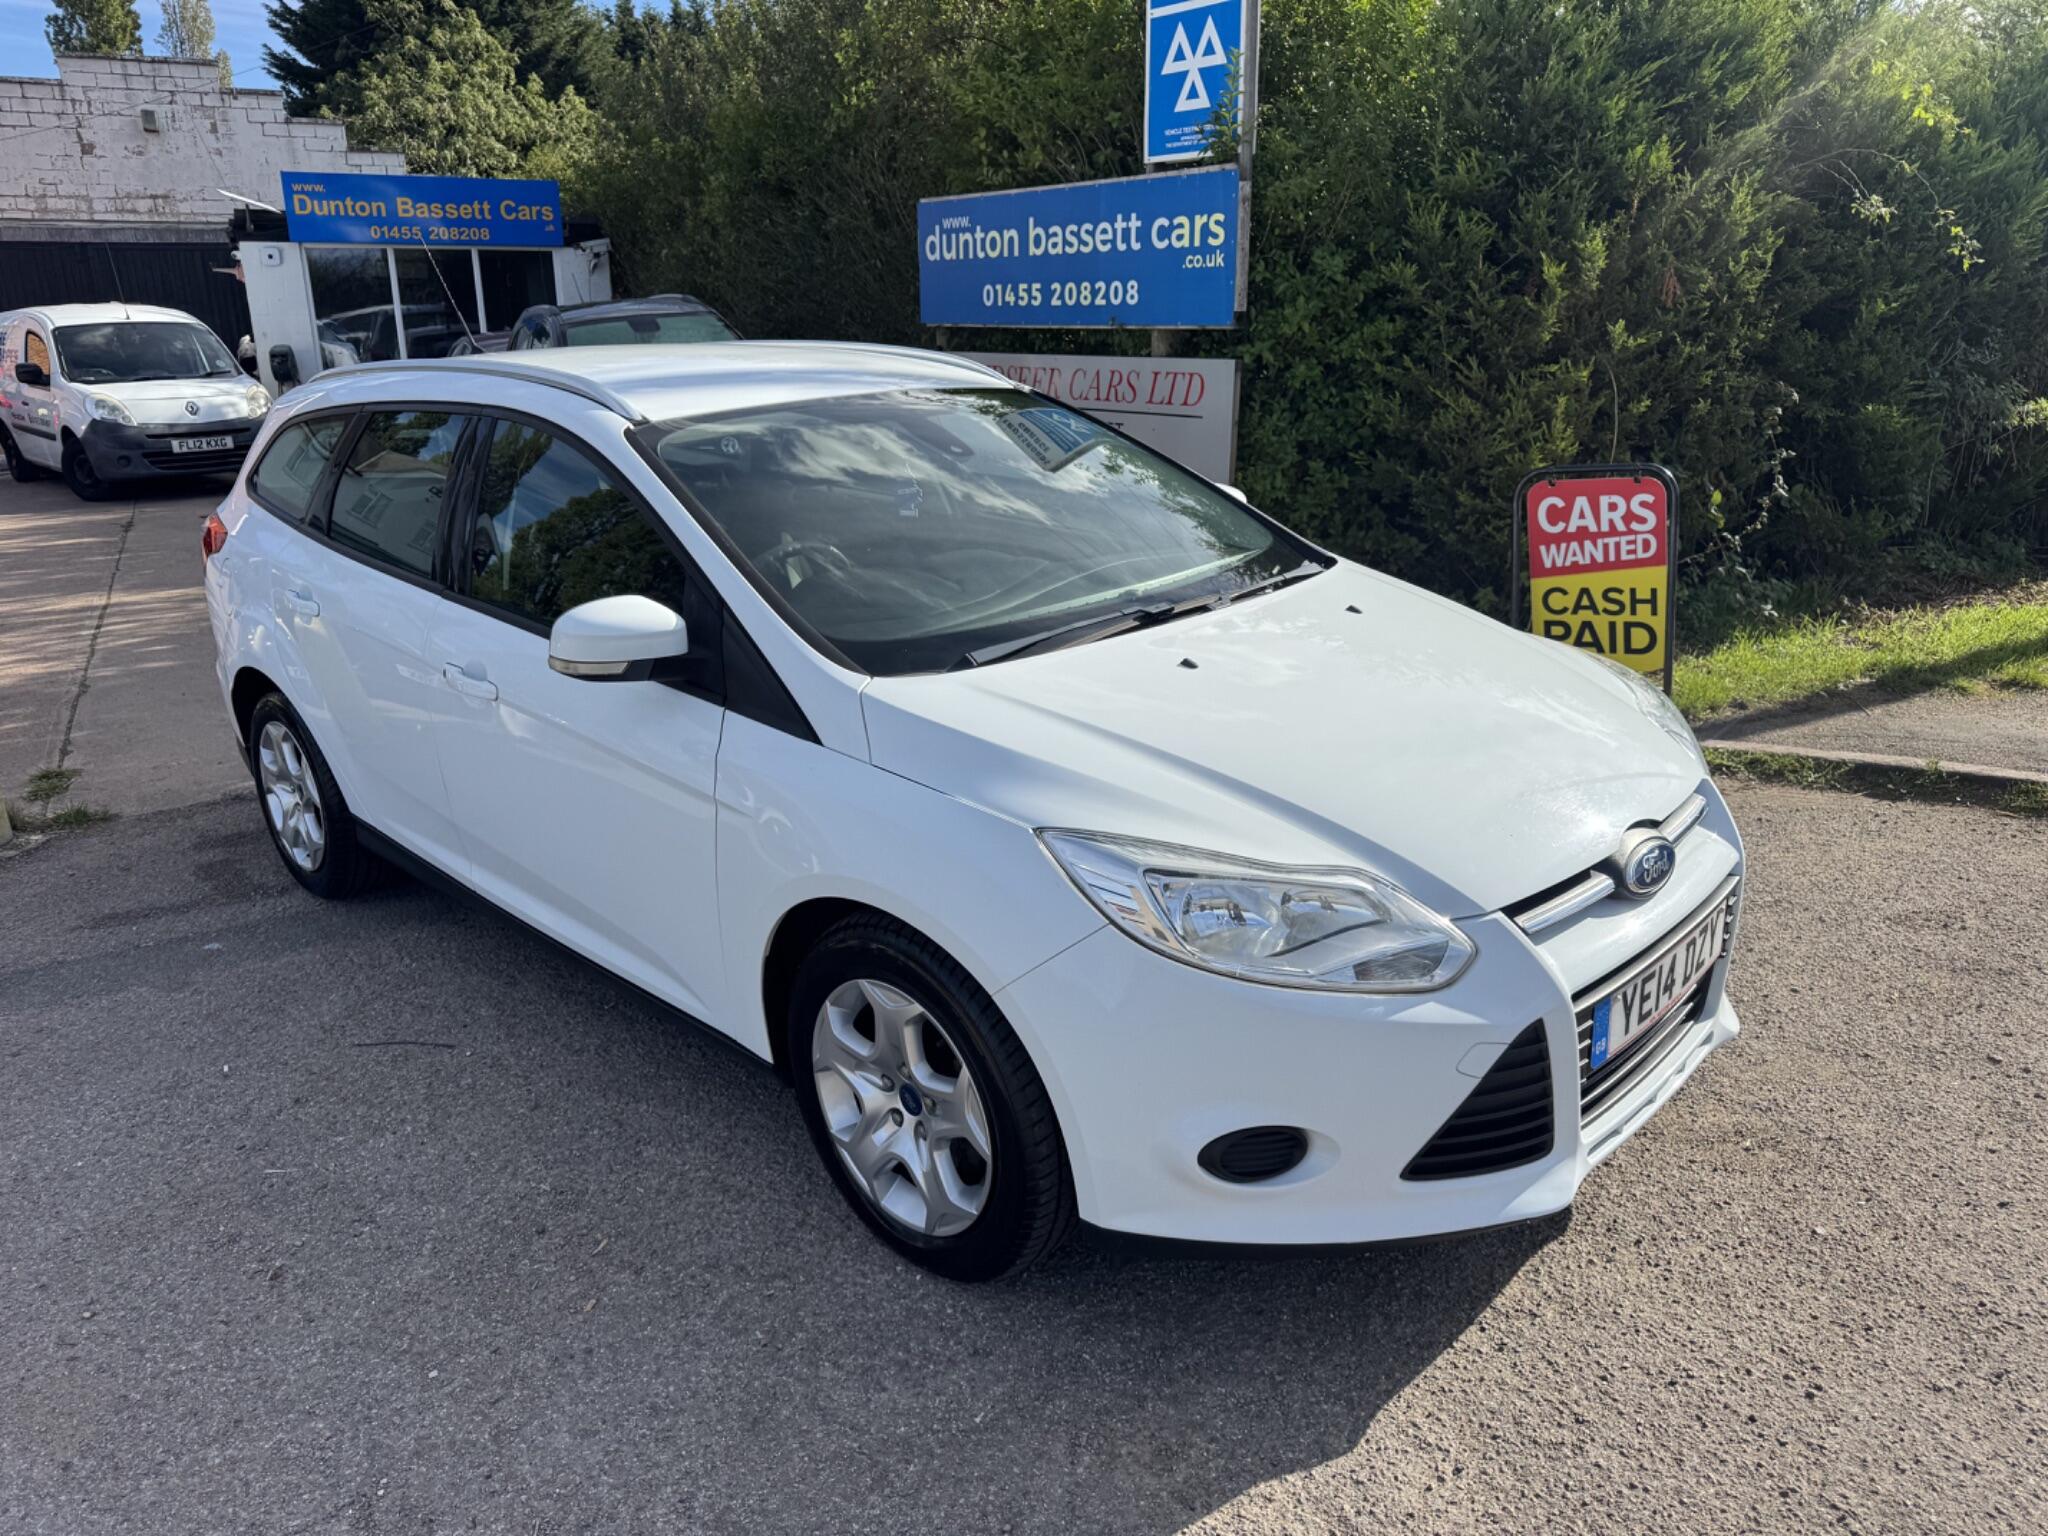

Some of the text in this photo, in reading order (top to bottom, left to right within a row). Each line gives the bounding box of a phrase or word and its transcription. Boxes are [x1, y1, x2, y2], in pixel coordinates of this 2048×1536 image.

[291, 183, 326, 193] www.
[293, 194, 554, 220] Dunton Bassett Cars
[370, 225, 490, 240] 01455 208208
[925, 212, 1225, 261] dunton bassett cars
[942, 216, 972, 229] www.
[1182, 250, 1224, 269] .co.uk
[982, 279, 1139, 307] 01455 208208
[1069, 367, 1139, 404] CARS
[1145, 371, 1205, 407] LTD
[178, 437, 228, 451] FL12 KXG
[1537, 493, 1657, 534] CARS
[1539, 533, 1657, 569] WANTED
[1542, 587, 1658, 617] CASH
[1543, 620, 1658, 655] PAID
[1641, 849, 1670, 883] Ford
[1622, 952, 1678, 1036] YE14
[1682, 912, 1722, 987] DZY
